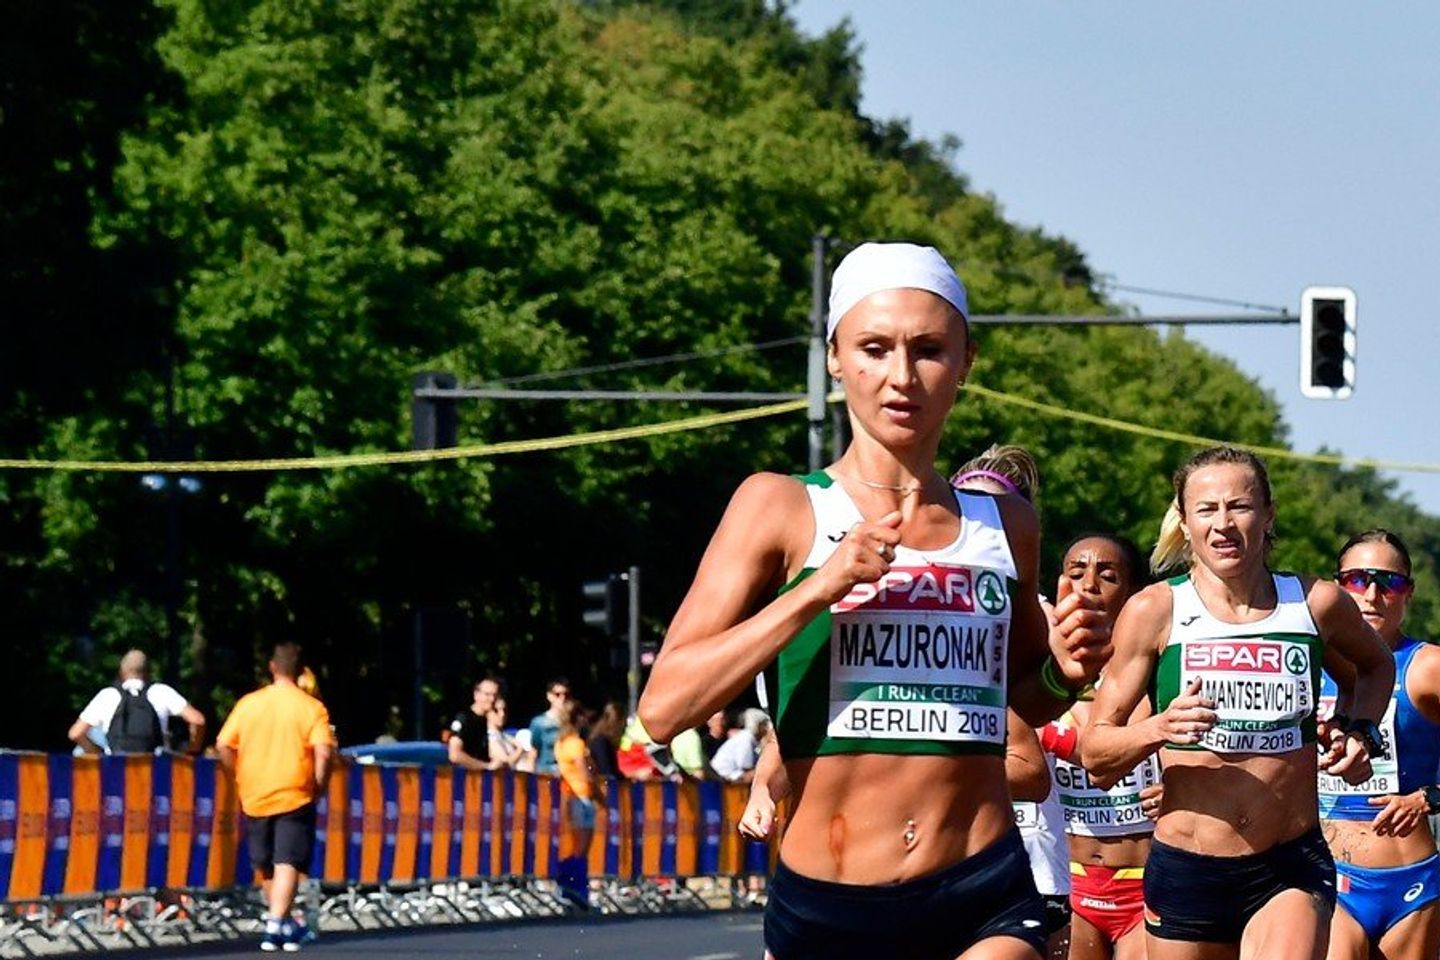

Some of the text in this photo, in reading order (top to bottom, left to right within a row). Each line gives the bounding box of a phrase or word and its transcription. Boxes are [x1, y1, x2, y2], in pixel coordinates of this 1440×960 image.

[839, 623, 989, 672] MAZURONAK
[1187, 645, 1280, 670] SPAR
[877, 684, 884, 700] I
[888, 685, 926, 701] RUN
[1187, 679, 1294, 712] MANTSEVICH
[852, 708, 998, 736] BERLIN 2018
[1205, 731, 1294, 750] ERLIN 2018
[1063, 807, 1111, 824] BERLIN
